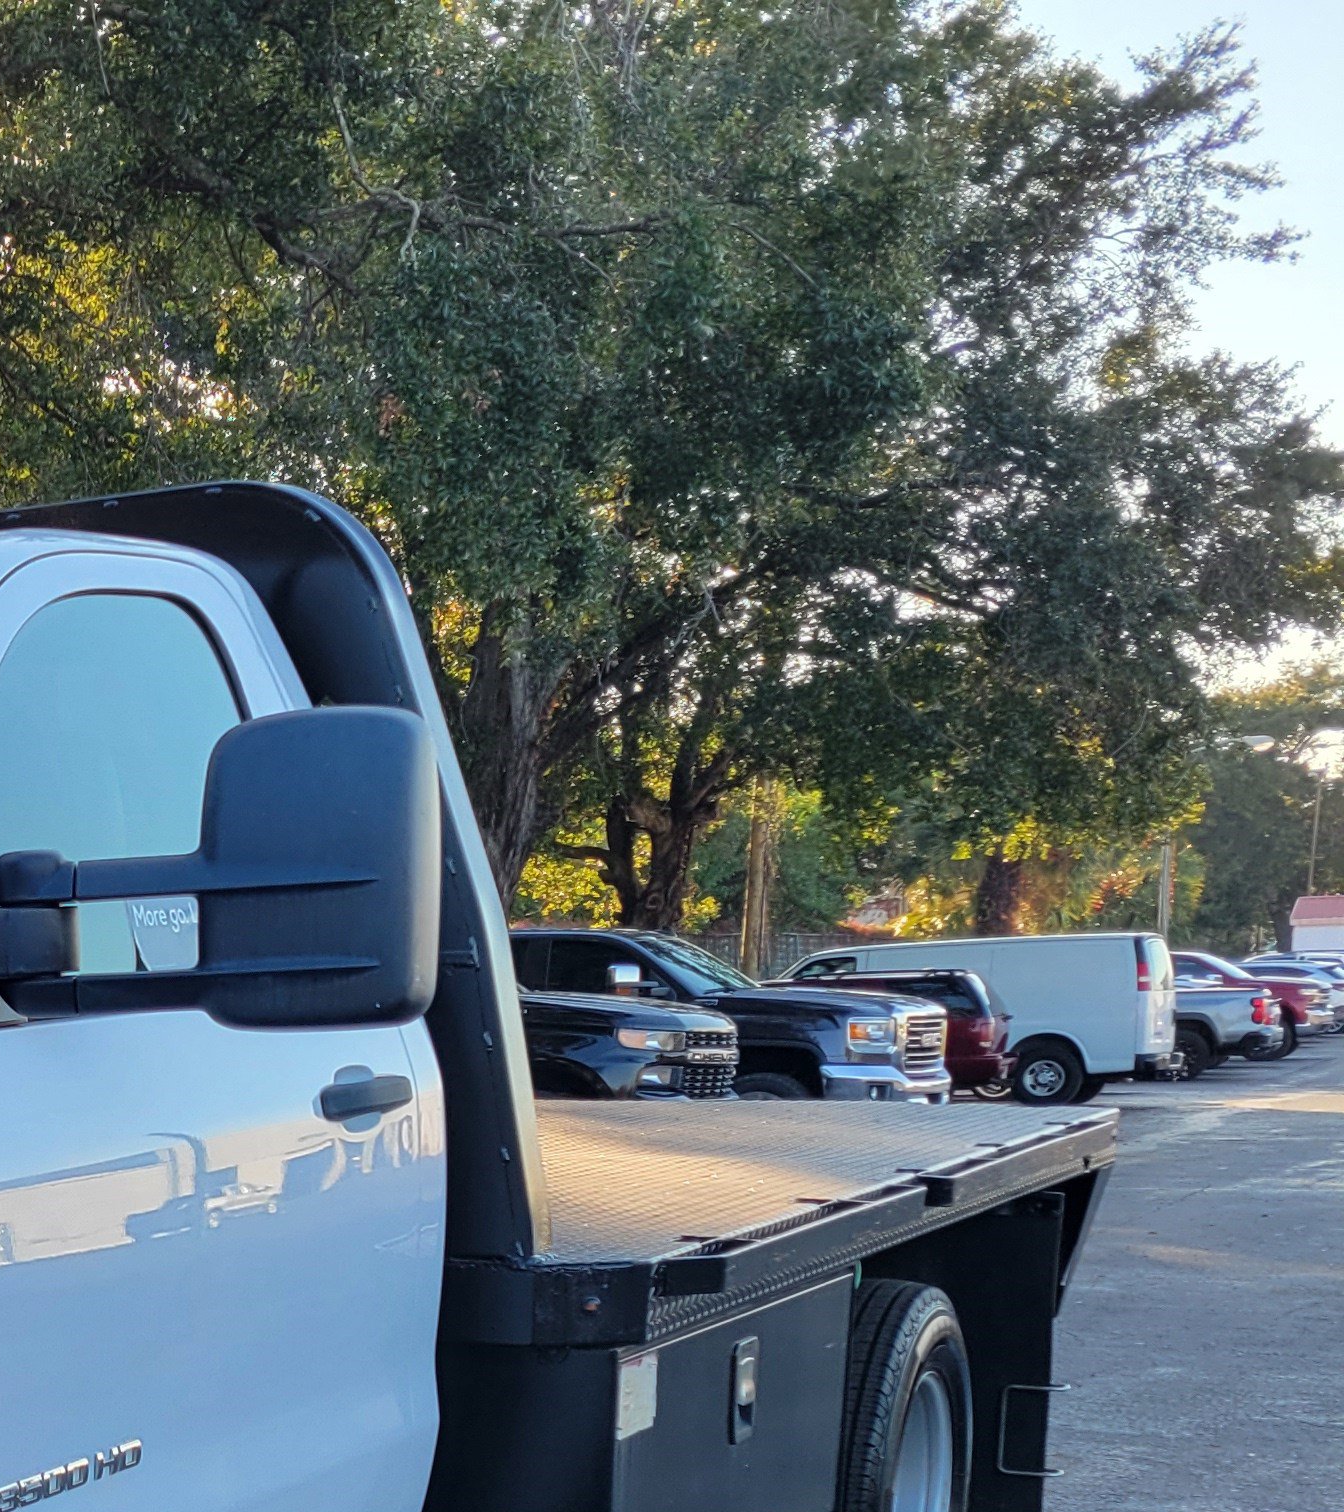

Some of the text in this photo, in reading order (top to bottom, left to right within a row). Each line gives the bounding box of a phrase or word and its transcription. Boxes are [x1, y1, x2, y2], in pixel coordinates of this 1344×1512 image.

[132, 904, 168, 928] More
[169, 908, 189, 933] go.
[94, 1438, 142, 1480] HD
